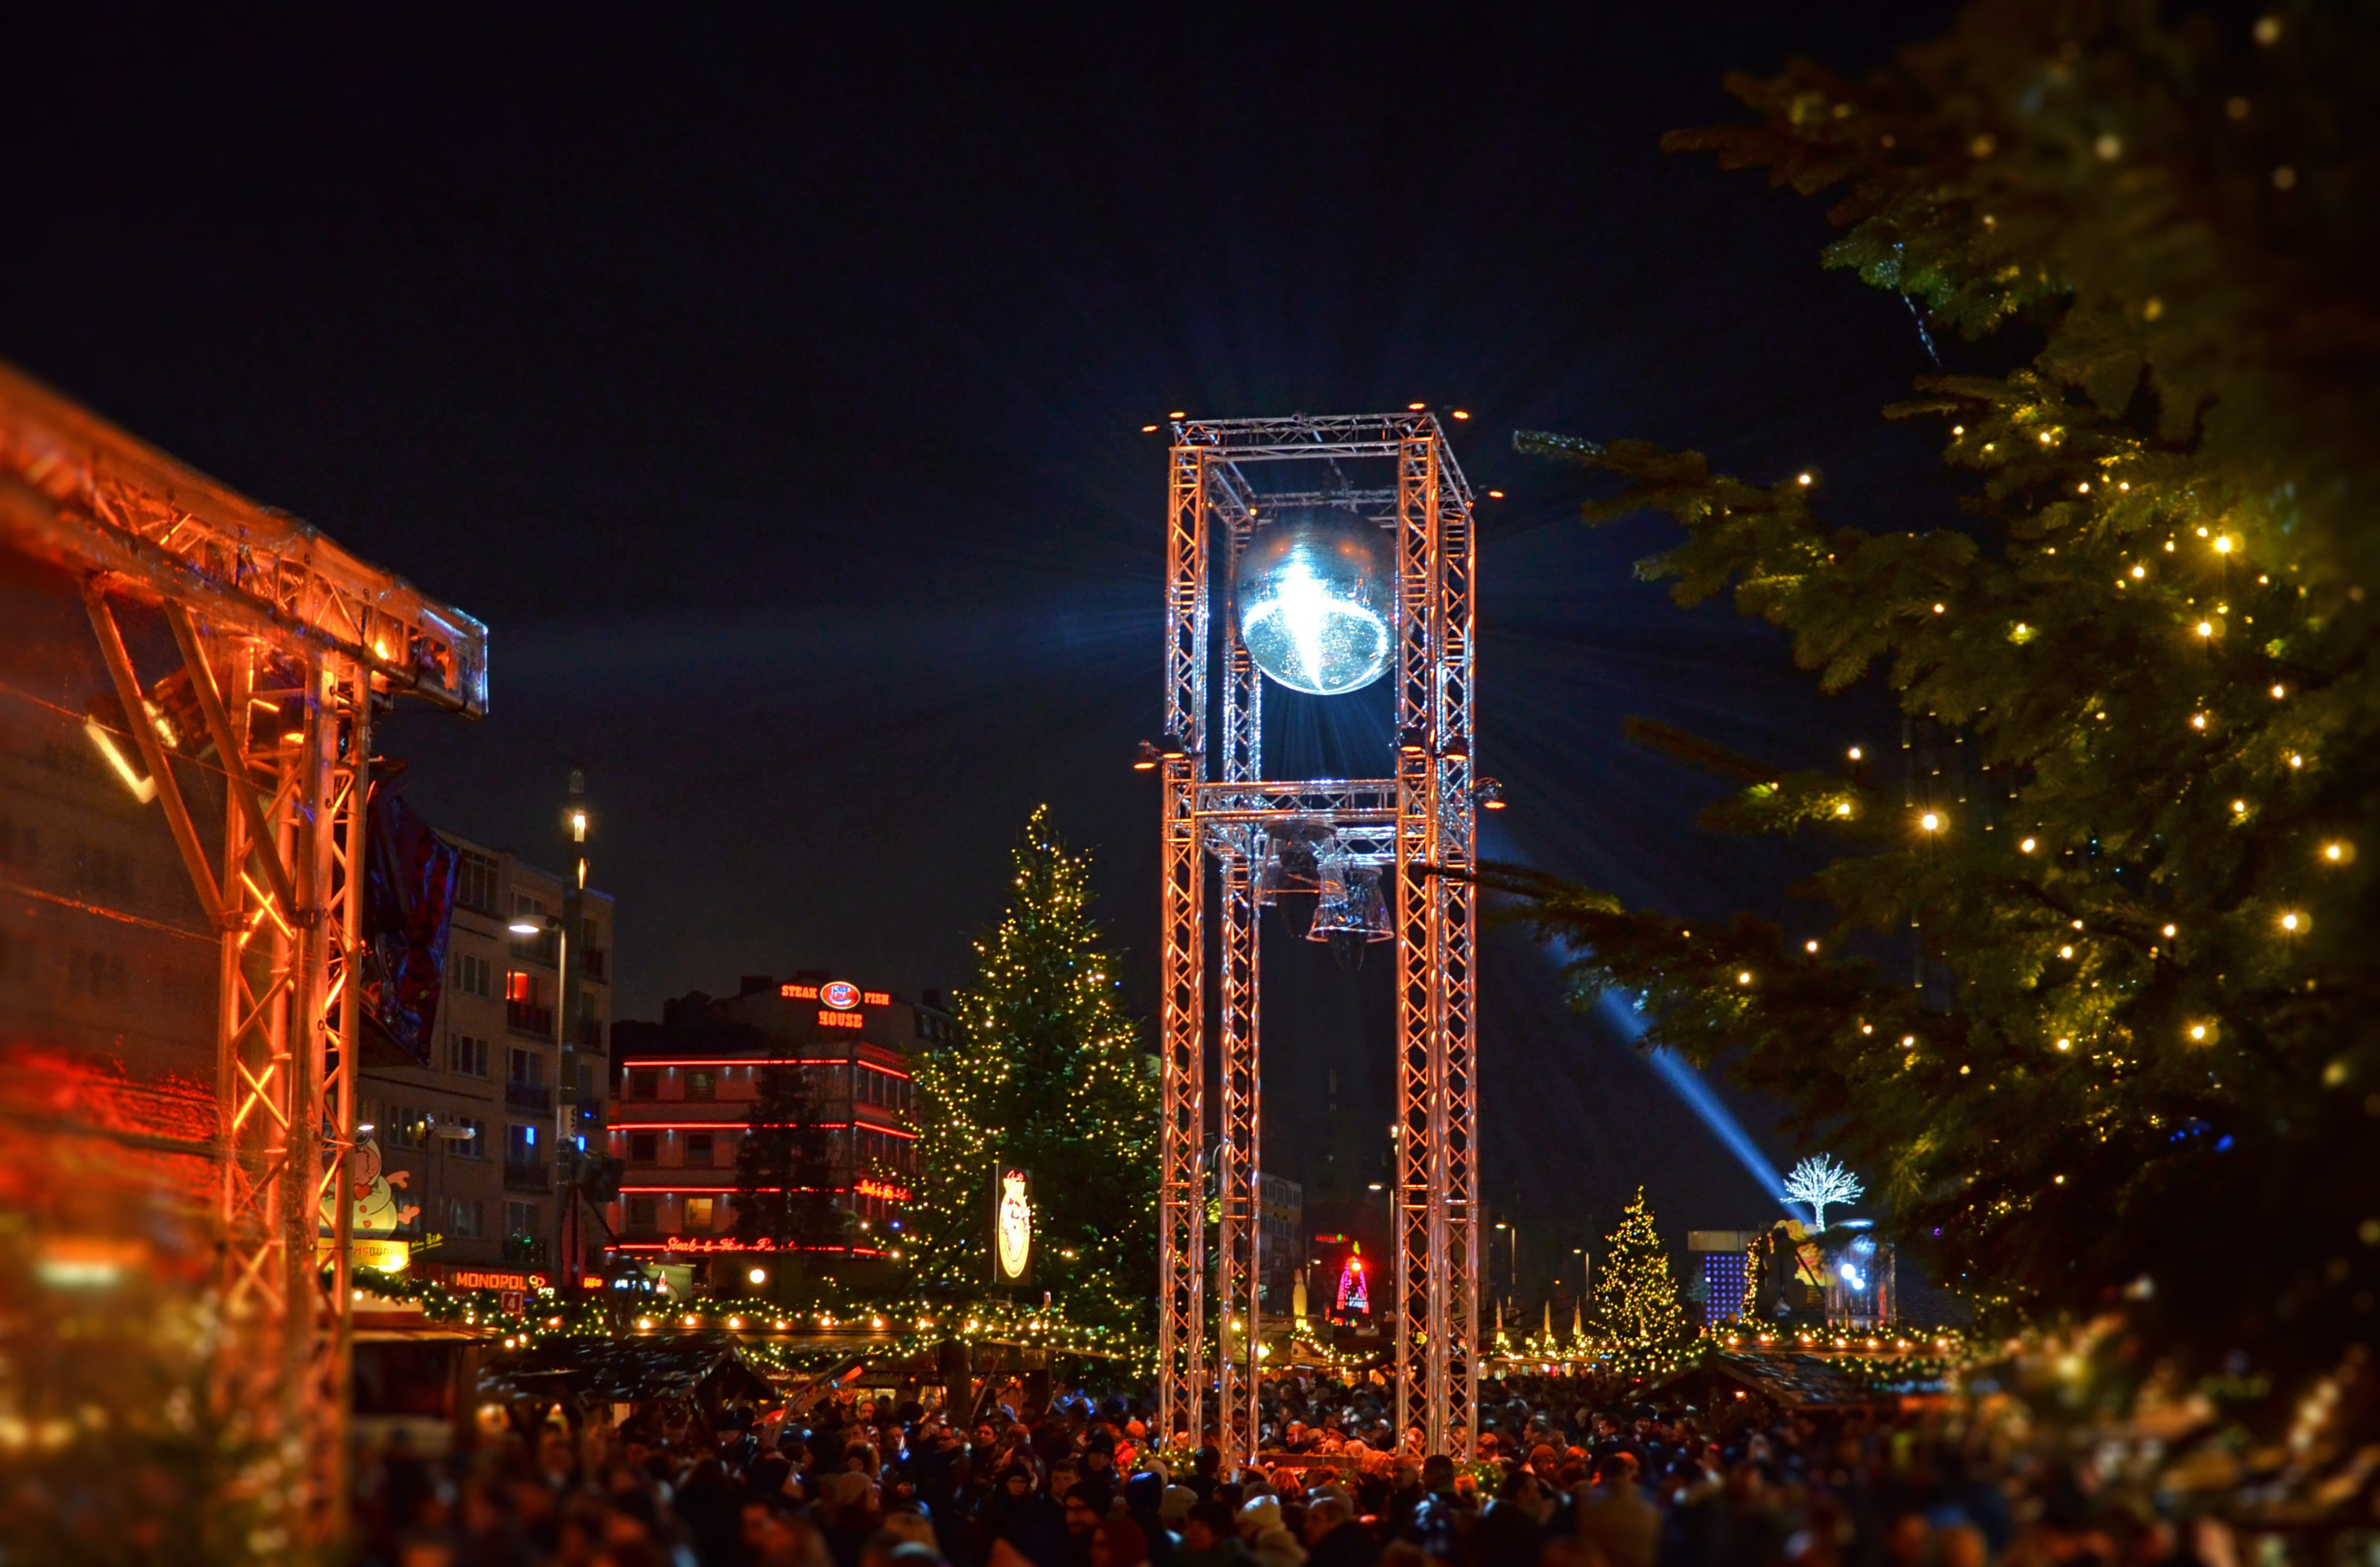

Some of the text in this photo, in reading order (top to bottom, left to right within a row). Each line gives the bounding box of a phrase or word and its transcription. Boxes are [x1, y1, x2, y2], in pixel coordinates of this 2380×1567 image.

[781, 985, 817, 999] STEAK
[818, 1011, 863, 1028] HOUSE
[664, 1236, 697, 1252] Steak
[456, 1272, 527, 1290] MONOPOL
[508, 1297, 516, 1309] 4
